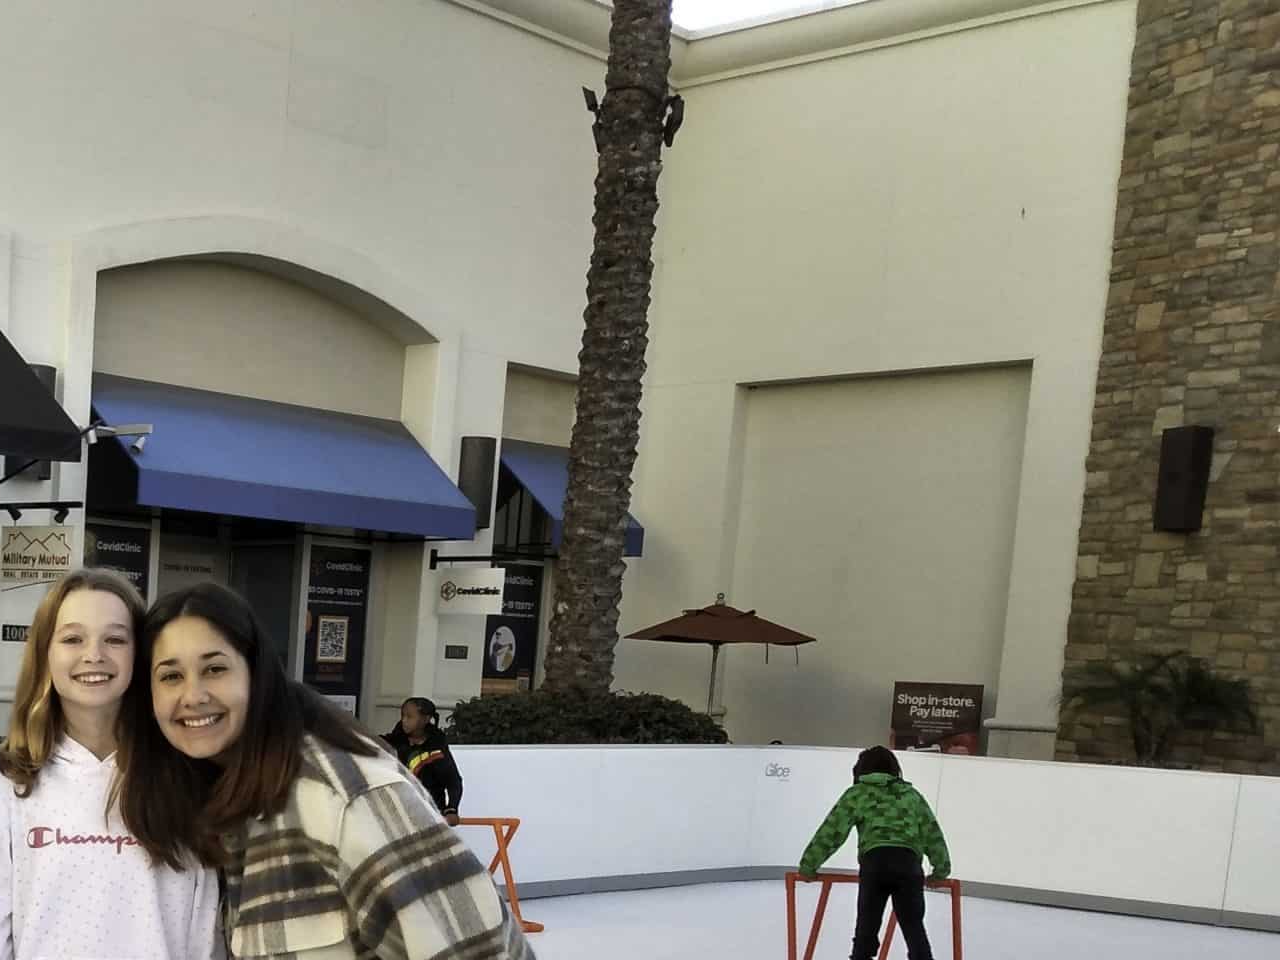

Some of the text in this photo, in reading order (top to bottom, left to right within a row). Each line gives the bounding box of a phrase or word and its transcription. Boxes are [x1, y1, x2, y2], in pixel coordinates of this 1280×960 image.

[2, 551, 70, 567] Military Mutual
[457, 587, 501, 595] CovidClinic
[5, 626, 26, 640] 100
[897, 693, 976, 707] Shop in-store.
[909, 706, 960, 718] Pay later.
